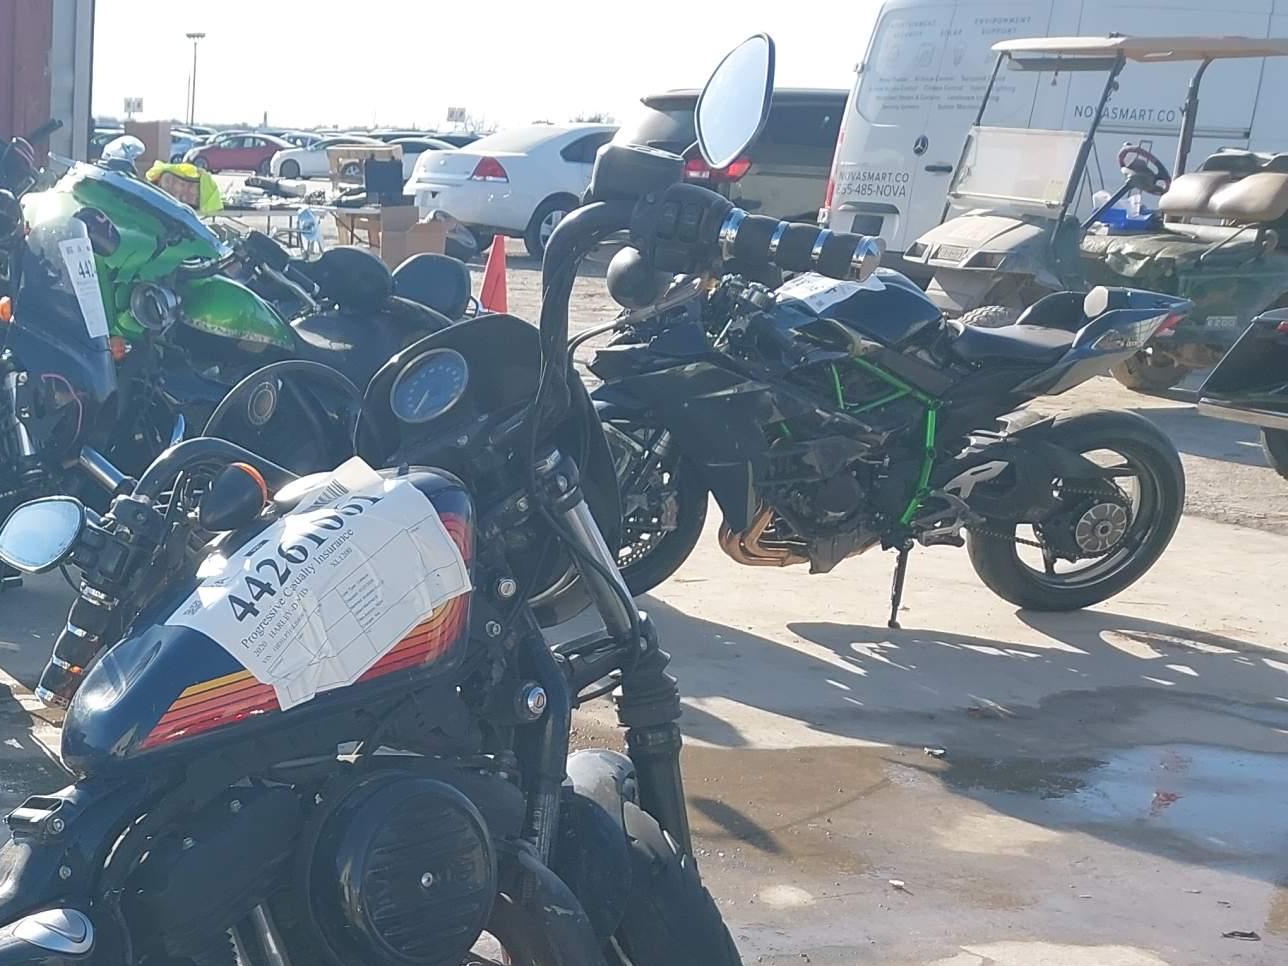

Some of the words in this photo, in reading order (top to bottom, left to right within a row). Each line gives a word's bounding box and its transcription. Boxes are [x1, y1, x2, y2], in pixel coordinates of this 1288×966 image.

[227, 495, 385, 624] 44261061
[240, 597, 286, 649] Progressive
[315, 528, 354, 566] Insurance
